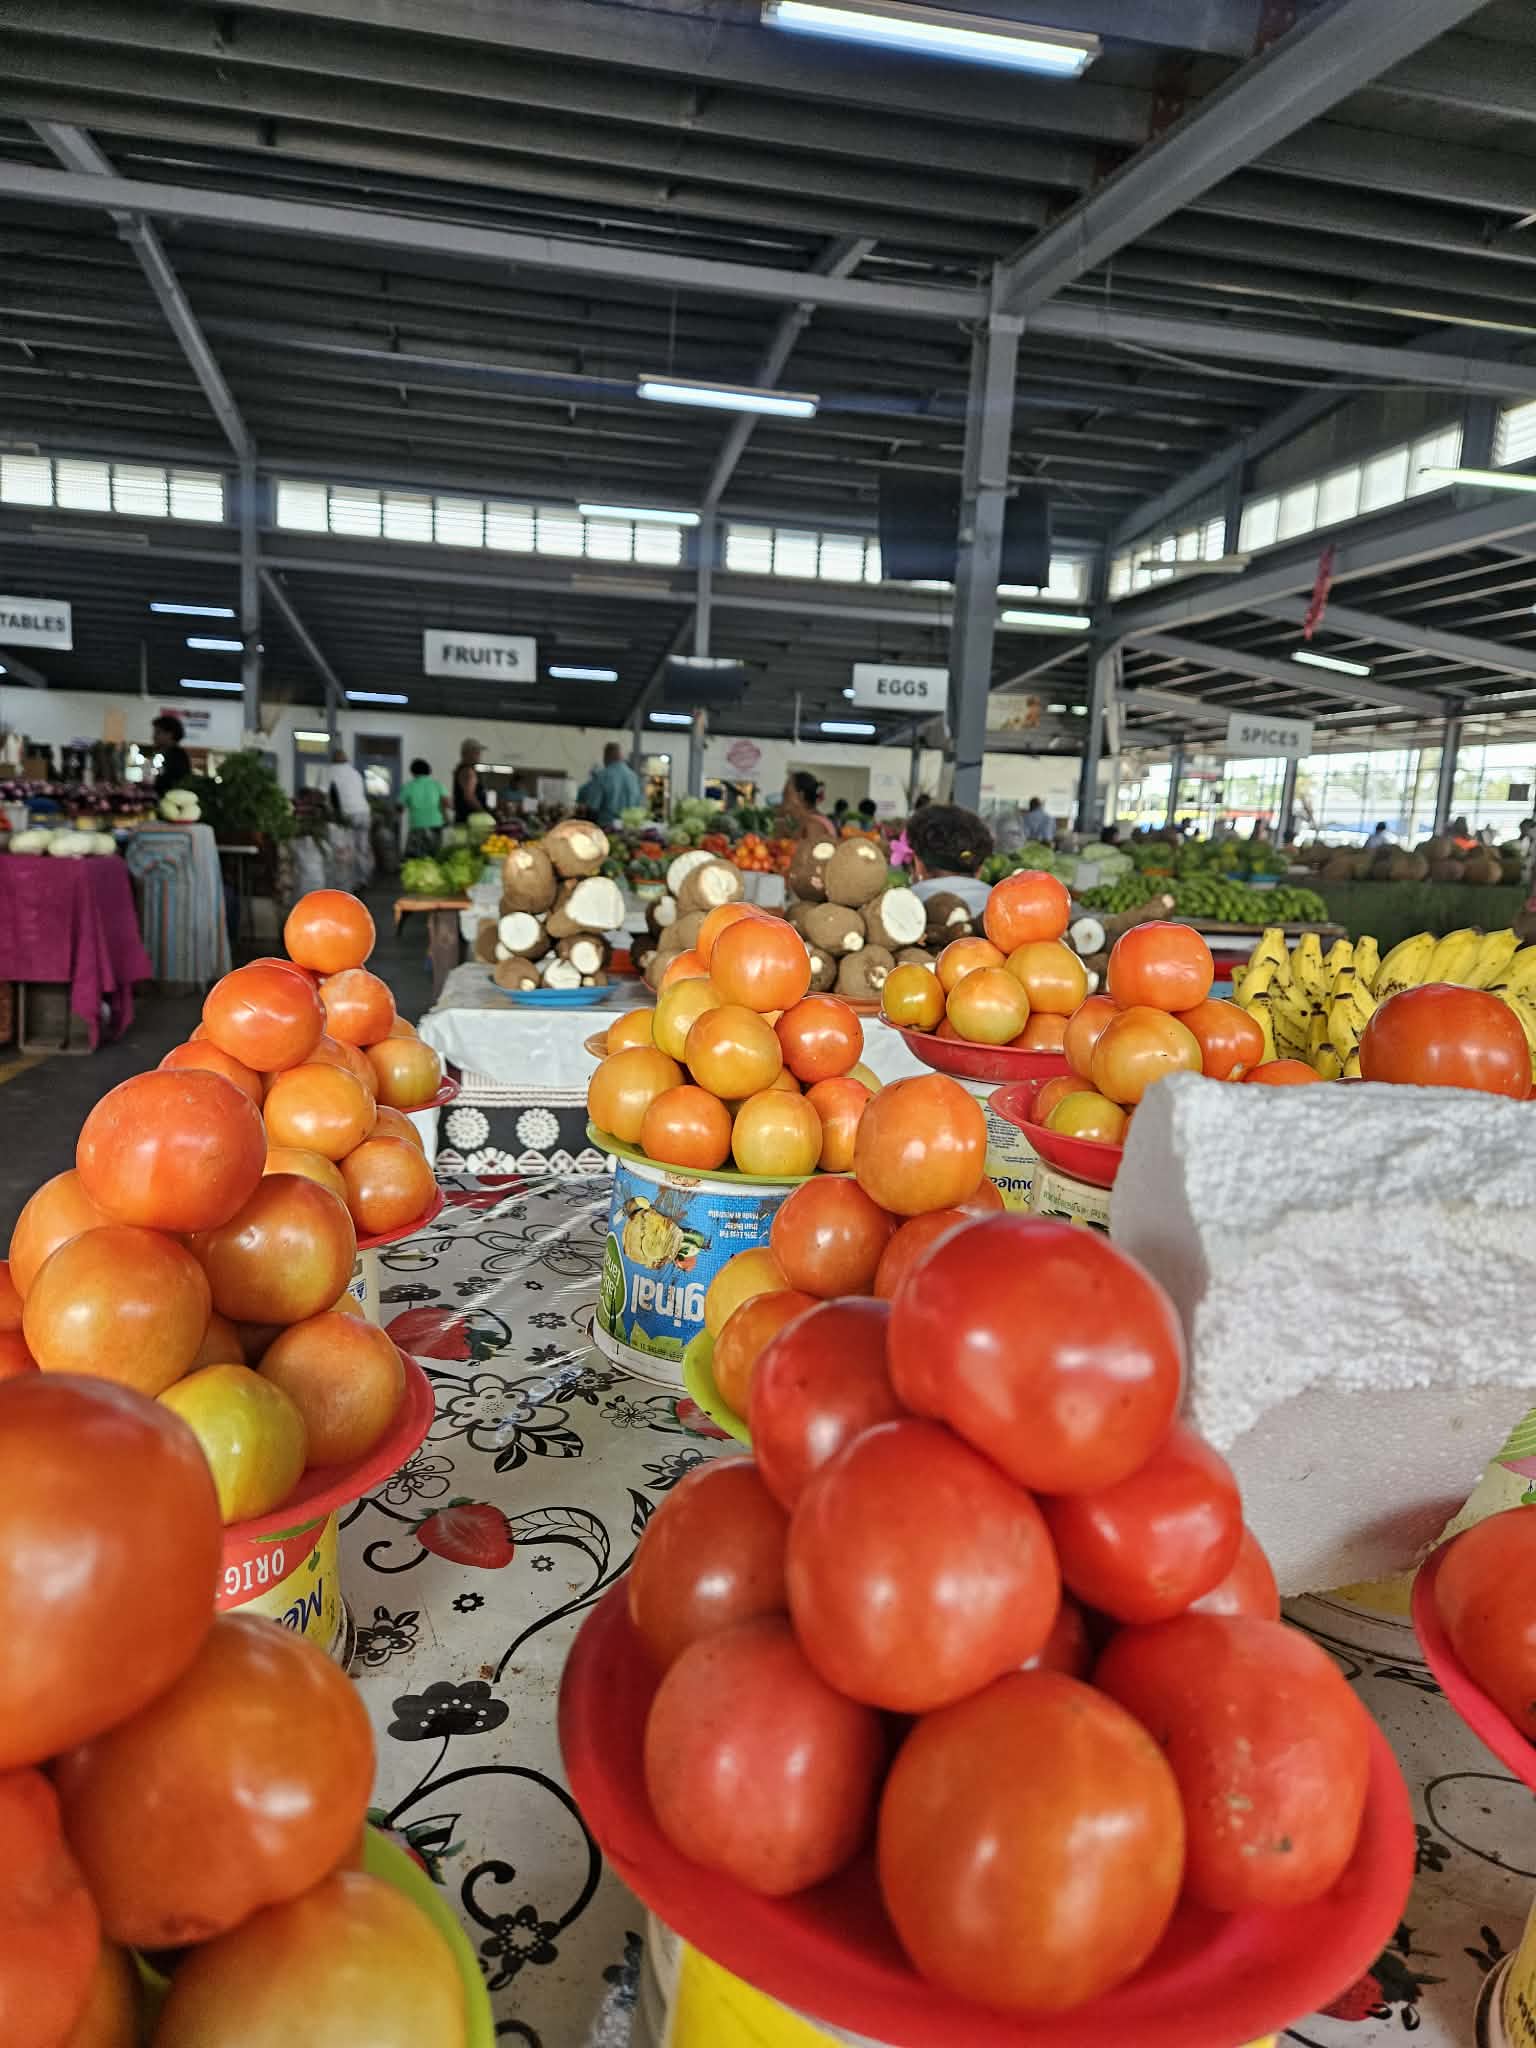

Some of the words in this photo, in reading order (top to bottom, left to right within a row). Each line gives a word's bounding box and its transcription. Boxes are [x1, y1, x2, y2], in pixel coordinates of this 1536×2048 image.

[0, 612, 65, 632] TABLES
[442, 644, 519, 667] FRUITS
[877, 678, 928, 697] EGGS
[1241, 726, 1299, 748] SPICES
[744, 1223, 758, 1231] than
[215, 1548, 284, 1598] ORIG
